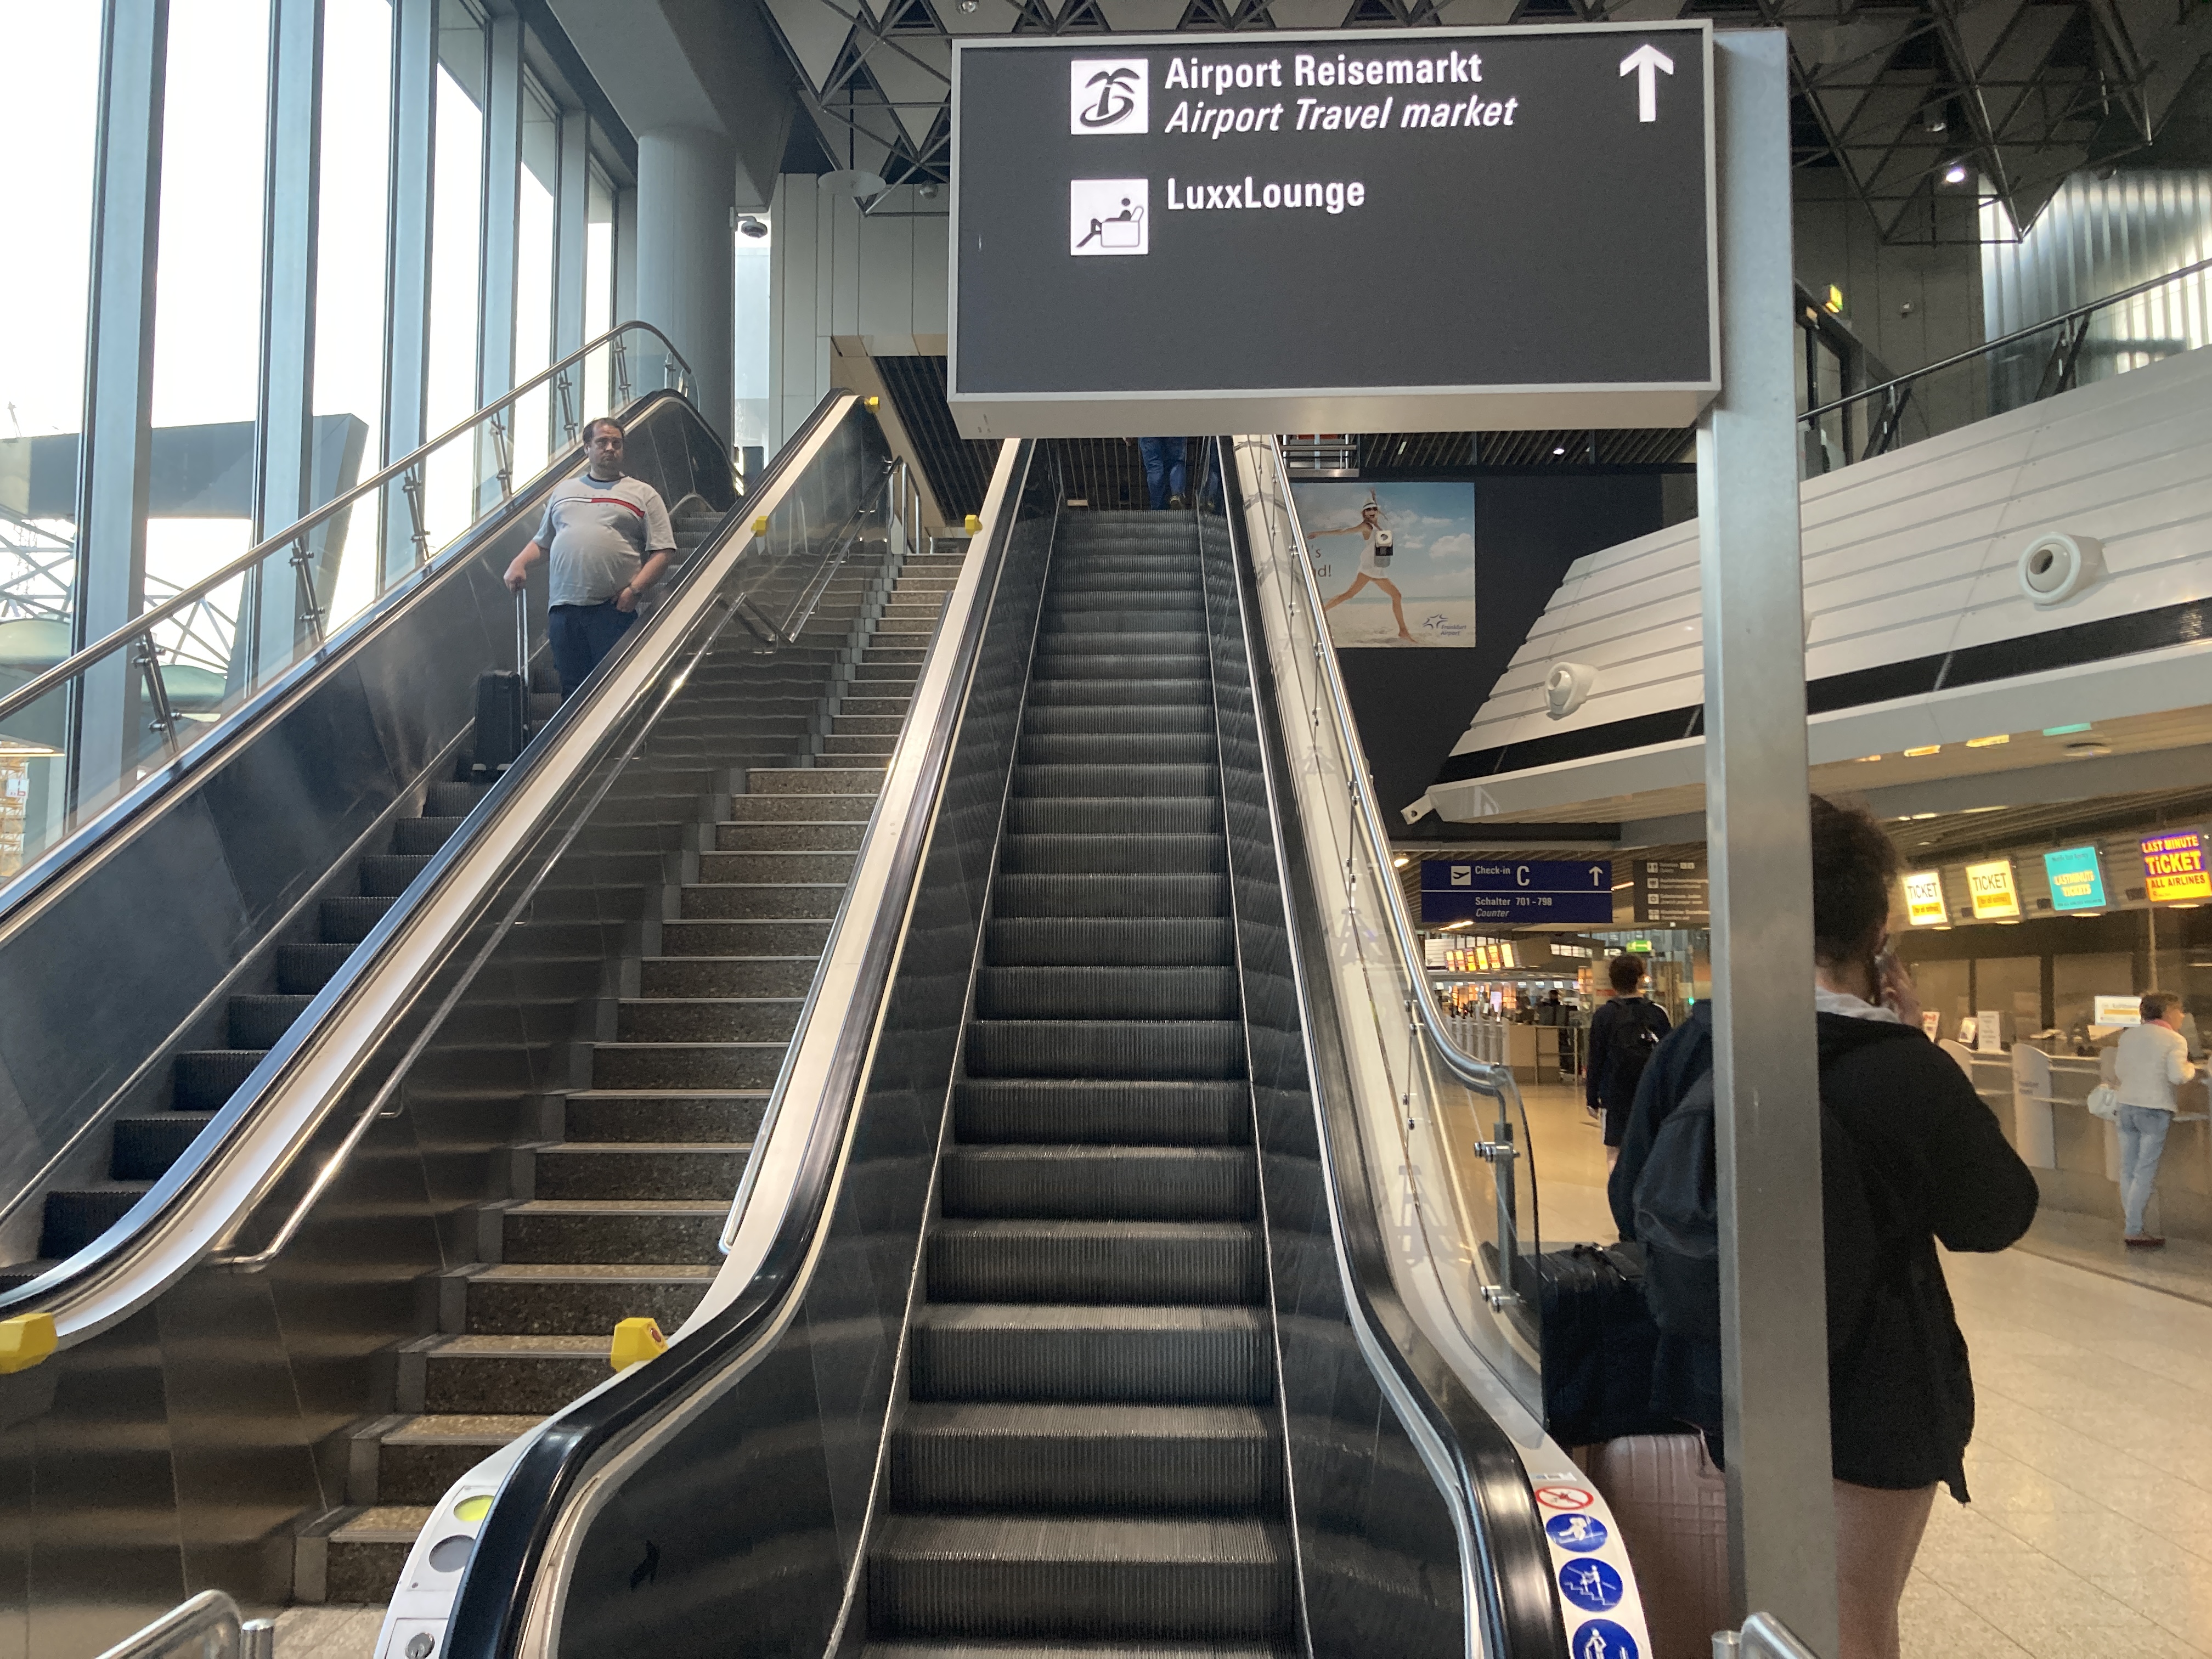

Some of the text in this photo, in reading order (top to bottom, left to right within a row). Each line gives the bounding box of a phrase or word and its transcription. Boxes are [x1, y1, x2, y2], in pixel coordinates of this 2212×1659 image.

[1164, 50, 1482, 95] Airport Reisemarkt
[1164, 94, 1518, 140] Airport Travel market
[1167, 176, 1365, 214] LuxxLounge
[2141, 834, 2199, 853] LAST MINUTE
[1475, 865, 1530, 886] Check-in C
[1972, 872, 2007, 891] TICKET
[2151, 874, 2205, 888] ALL AIRLINES
[1907, 882, 1938, 899] TICKET
[1475, 897, 1511, 906] Schalter
[1476, 908, 1510, 917] Counter
